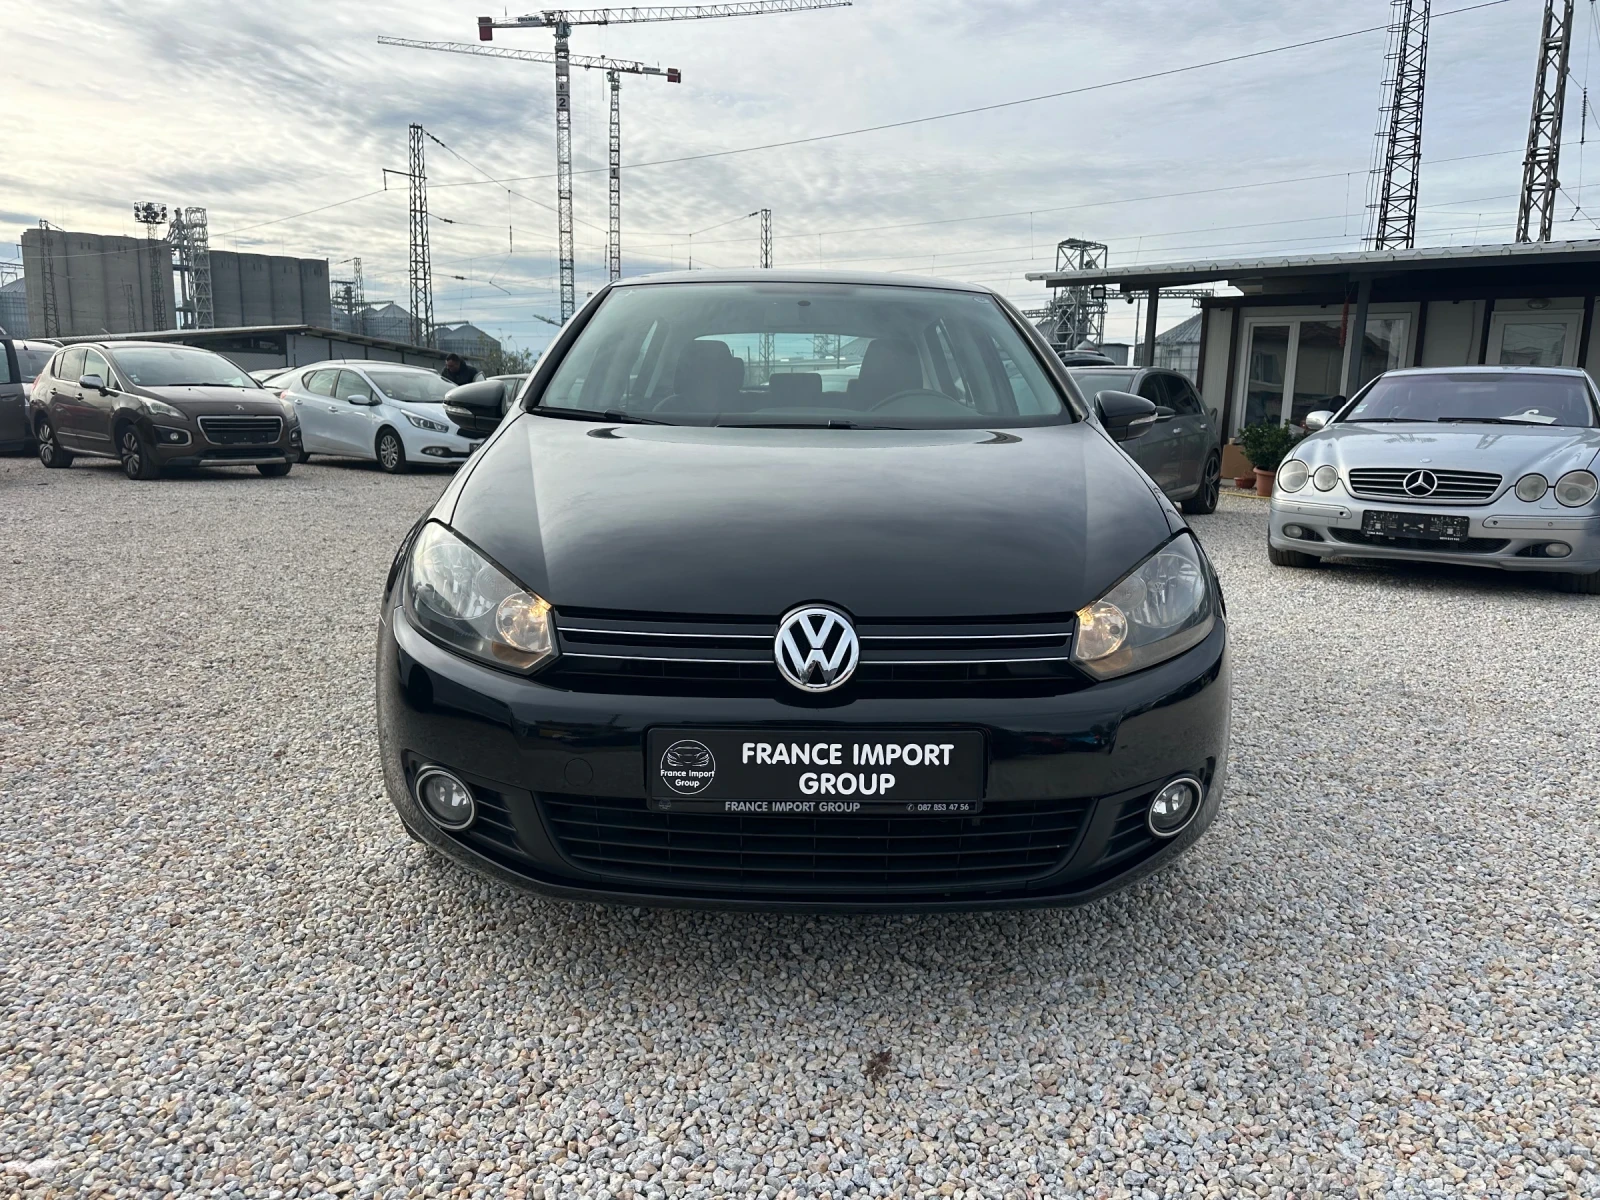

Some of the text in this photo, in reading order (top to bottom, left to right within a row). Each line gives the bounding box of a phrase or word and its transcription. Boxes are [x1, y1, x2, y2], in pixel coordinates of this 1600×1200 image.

[558, 97, 566, 107] 2
[775, 607, 859, 689] VW
[742, 742, 955, 767] FRANCE IMPORT
[660, 769, 715, 779] France Import
[675, 778, 700, 788] Group
[798, 772, 896, 796] GROUP
[725, 801, 861, 813] FRANCE IMPORT GROUP
[948, 803, 959, 811] 47
[960, 803, 970, 811] 56
